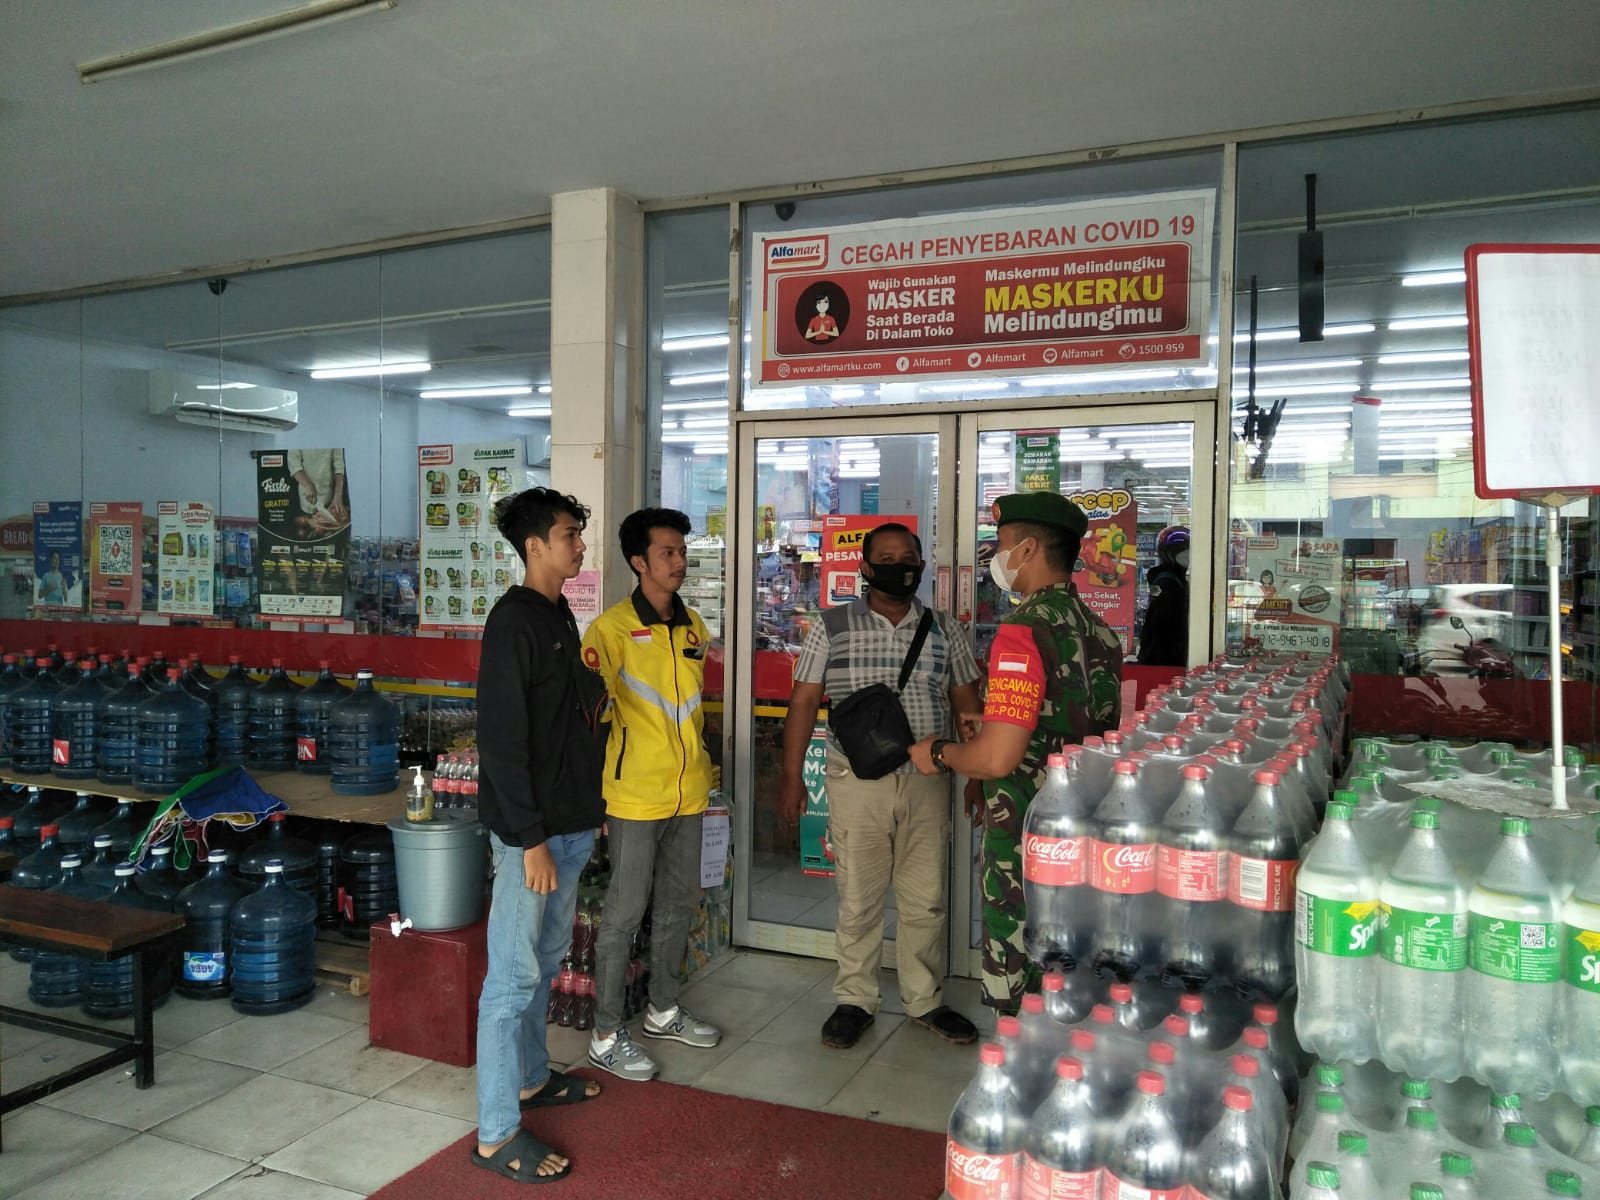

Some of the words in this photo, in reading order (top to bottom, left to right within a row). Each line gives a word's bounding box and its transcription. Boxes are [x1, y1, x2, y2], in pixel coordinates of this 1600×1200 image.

[841, 241, 913, 265] CEGAH
[922, 225, 1076, 258] PENYEBARAN
[1084, 218, 1160, 243] COVID
[1168, 215, 1195, 236] 19
[771, 243, 821, 258] Alfamart
[985, 267, 1059, 282] Maskermu
[1063, 256, 1165, 275] Melindungiku
[868, 278, 900, 291] Wajib
[903, 275, 956, 288] Gunakan
[868, 288, 955, 311] MASKER
[985, 274, 1163, 312] MASKERKU
[866, 314, 898, 328] Saat
[903, 310, 955, 325] Berada
[984, 305, 1162, 334] Melindungimu
[866, 329, 879, 341] Di
[882, 328, 921, 339] Dalam
[924, 326, 953, 337] Toko
[1061, 348, 1104, 359] Alfamart
[1139, 345, 1163, 355] 1500
[1165, 343, 1184, 353] 959
[913, 357, 952, 367] Alfamart
[985, 353, 1026, 364] Alfamart
[793, 361, 881, 374] www.alfamartku.com
[1313, 542, 1339, 551] SAPA
[1091, 601, 1121, 610] Ongkir
[1027, 836, 1081, 860] Coca-Cola
[1273, 864, 1281, 877] ME
[1273, 878, 1281, 911] RECYCLE
[190, 963, 214, 973] AQUA
